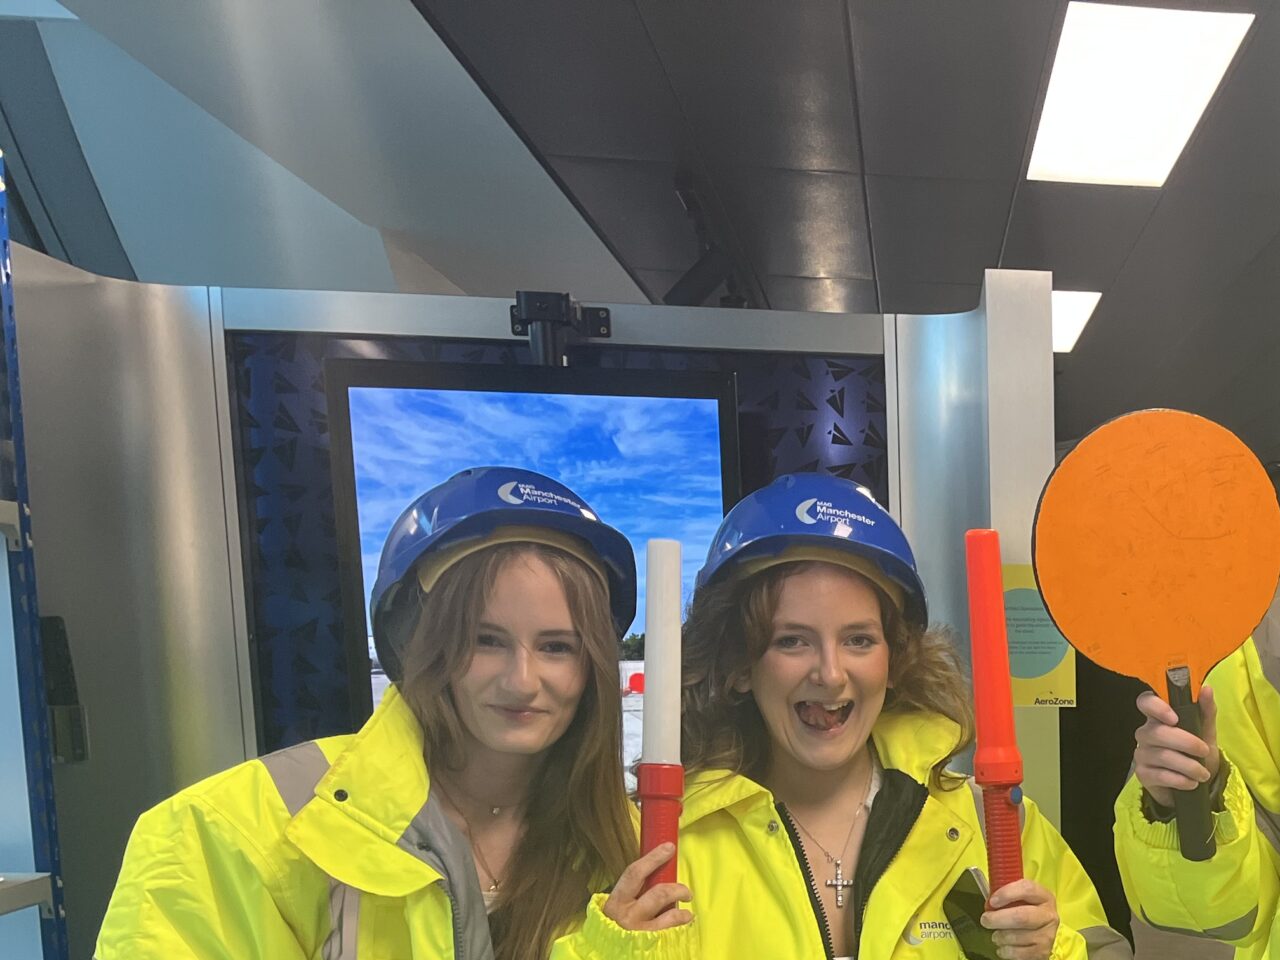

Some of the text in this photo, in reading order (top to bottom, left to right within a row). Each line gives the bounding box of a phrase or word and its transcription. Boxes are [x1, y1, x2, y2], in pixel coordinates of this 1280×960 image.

[520, 487, 581, 508] Manchester
[522, 493, 558, 506] Airport
[816, 506, 876, 526] Manchester
[816, 513, 850, 525] Airport
[1034, 697, 1074, 706] AeroZone
